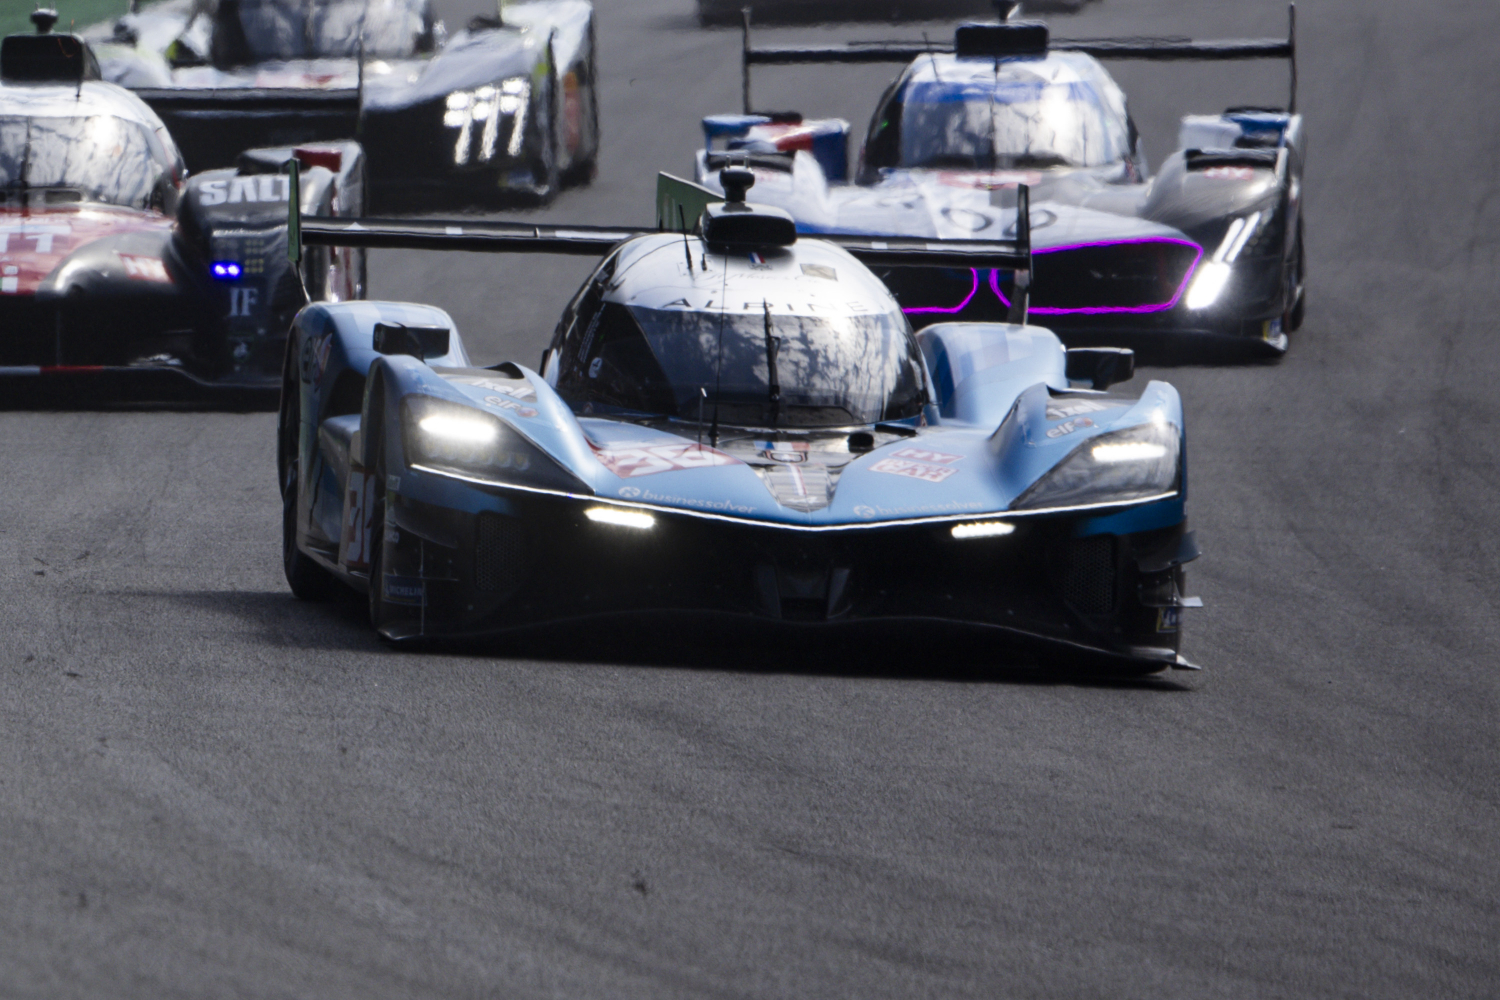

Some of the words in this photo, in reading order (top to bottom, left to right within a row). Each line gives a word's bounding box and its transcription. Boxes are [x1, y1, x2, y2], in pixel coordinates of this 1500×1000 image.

[229, 287, 259, 318] IF
[661, 298, 869, 314] ALPINE
[876, 464, 944, 481] CAR
[642, 489, 758, 514] businessolver
[875, 500, 984, 516] businessolver
